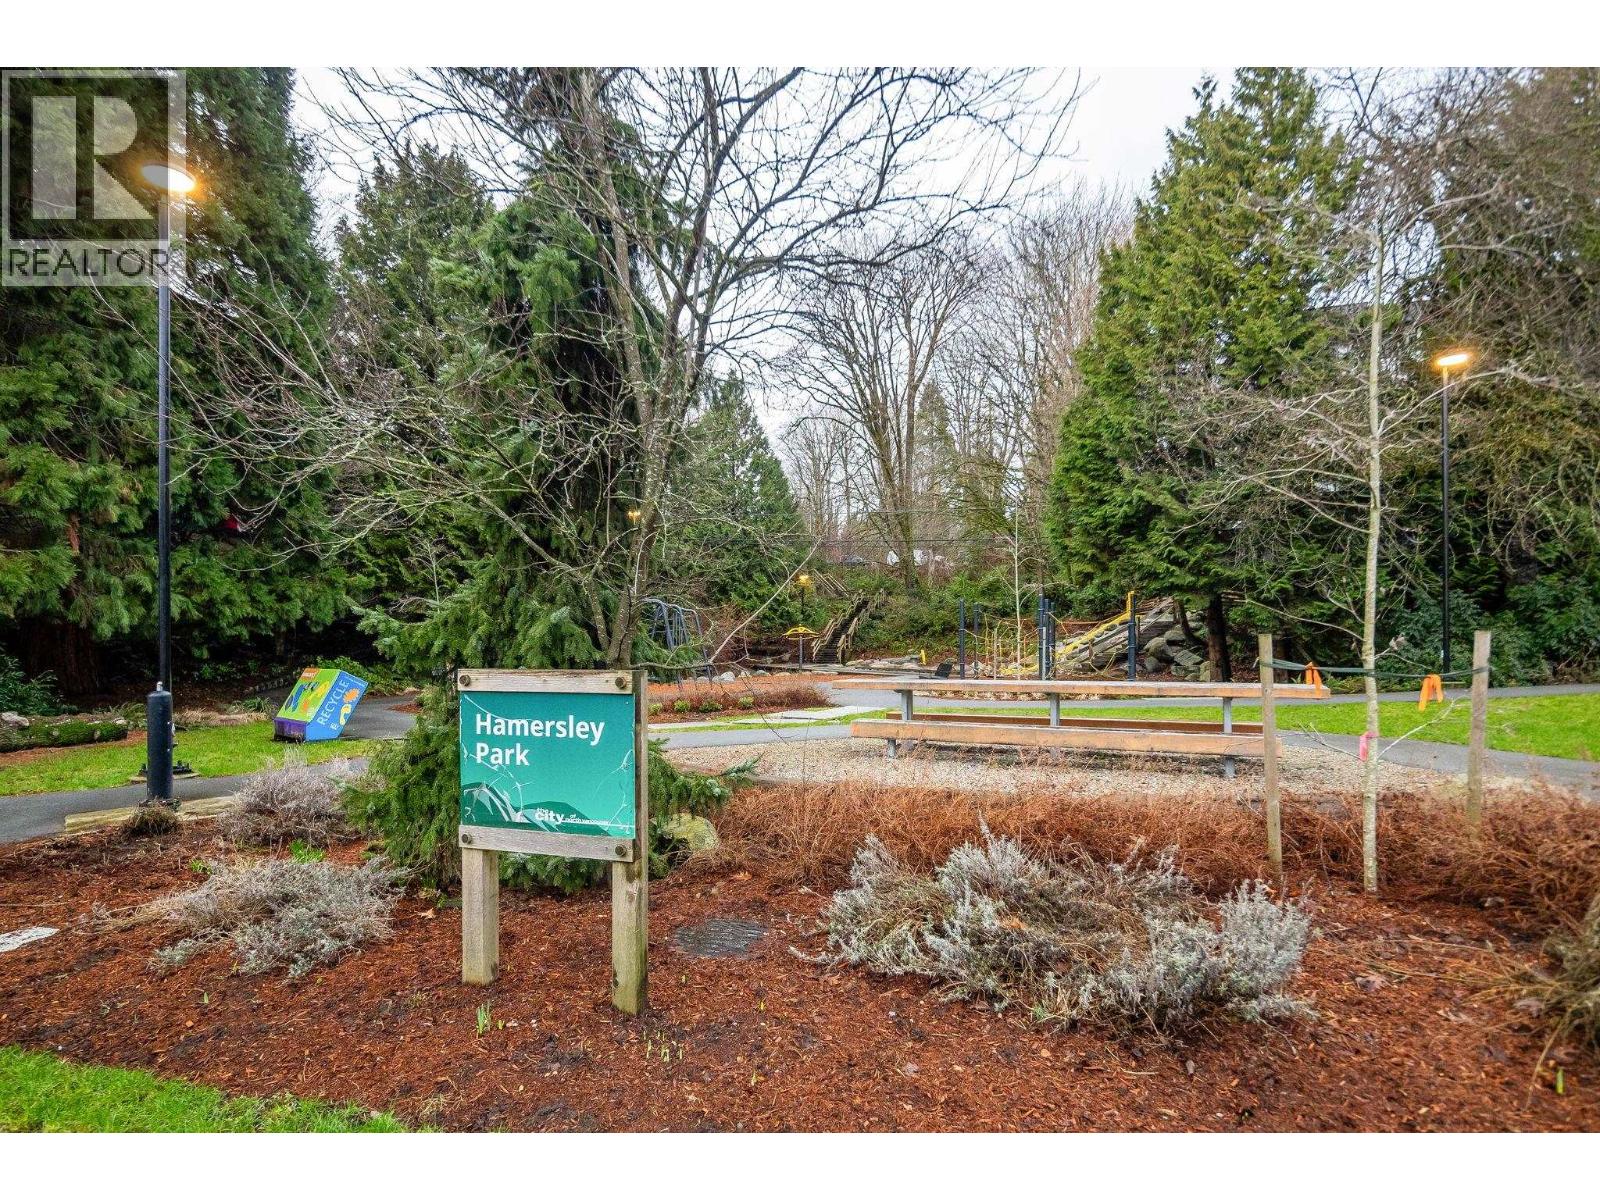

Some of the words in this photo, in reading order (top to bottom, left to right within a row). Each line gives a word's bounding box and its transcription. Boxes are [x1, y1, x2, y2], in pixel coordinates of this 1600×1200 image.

[316, 680, 350, 725] RECYCLE
[475, 713, 606, 746] Hamersley
[475, 742, 531, 766] Park
[535, 811, 564, 825] city
